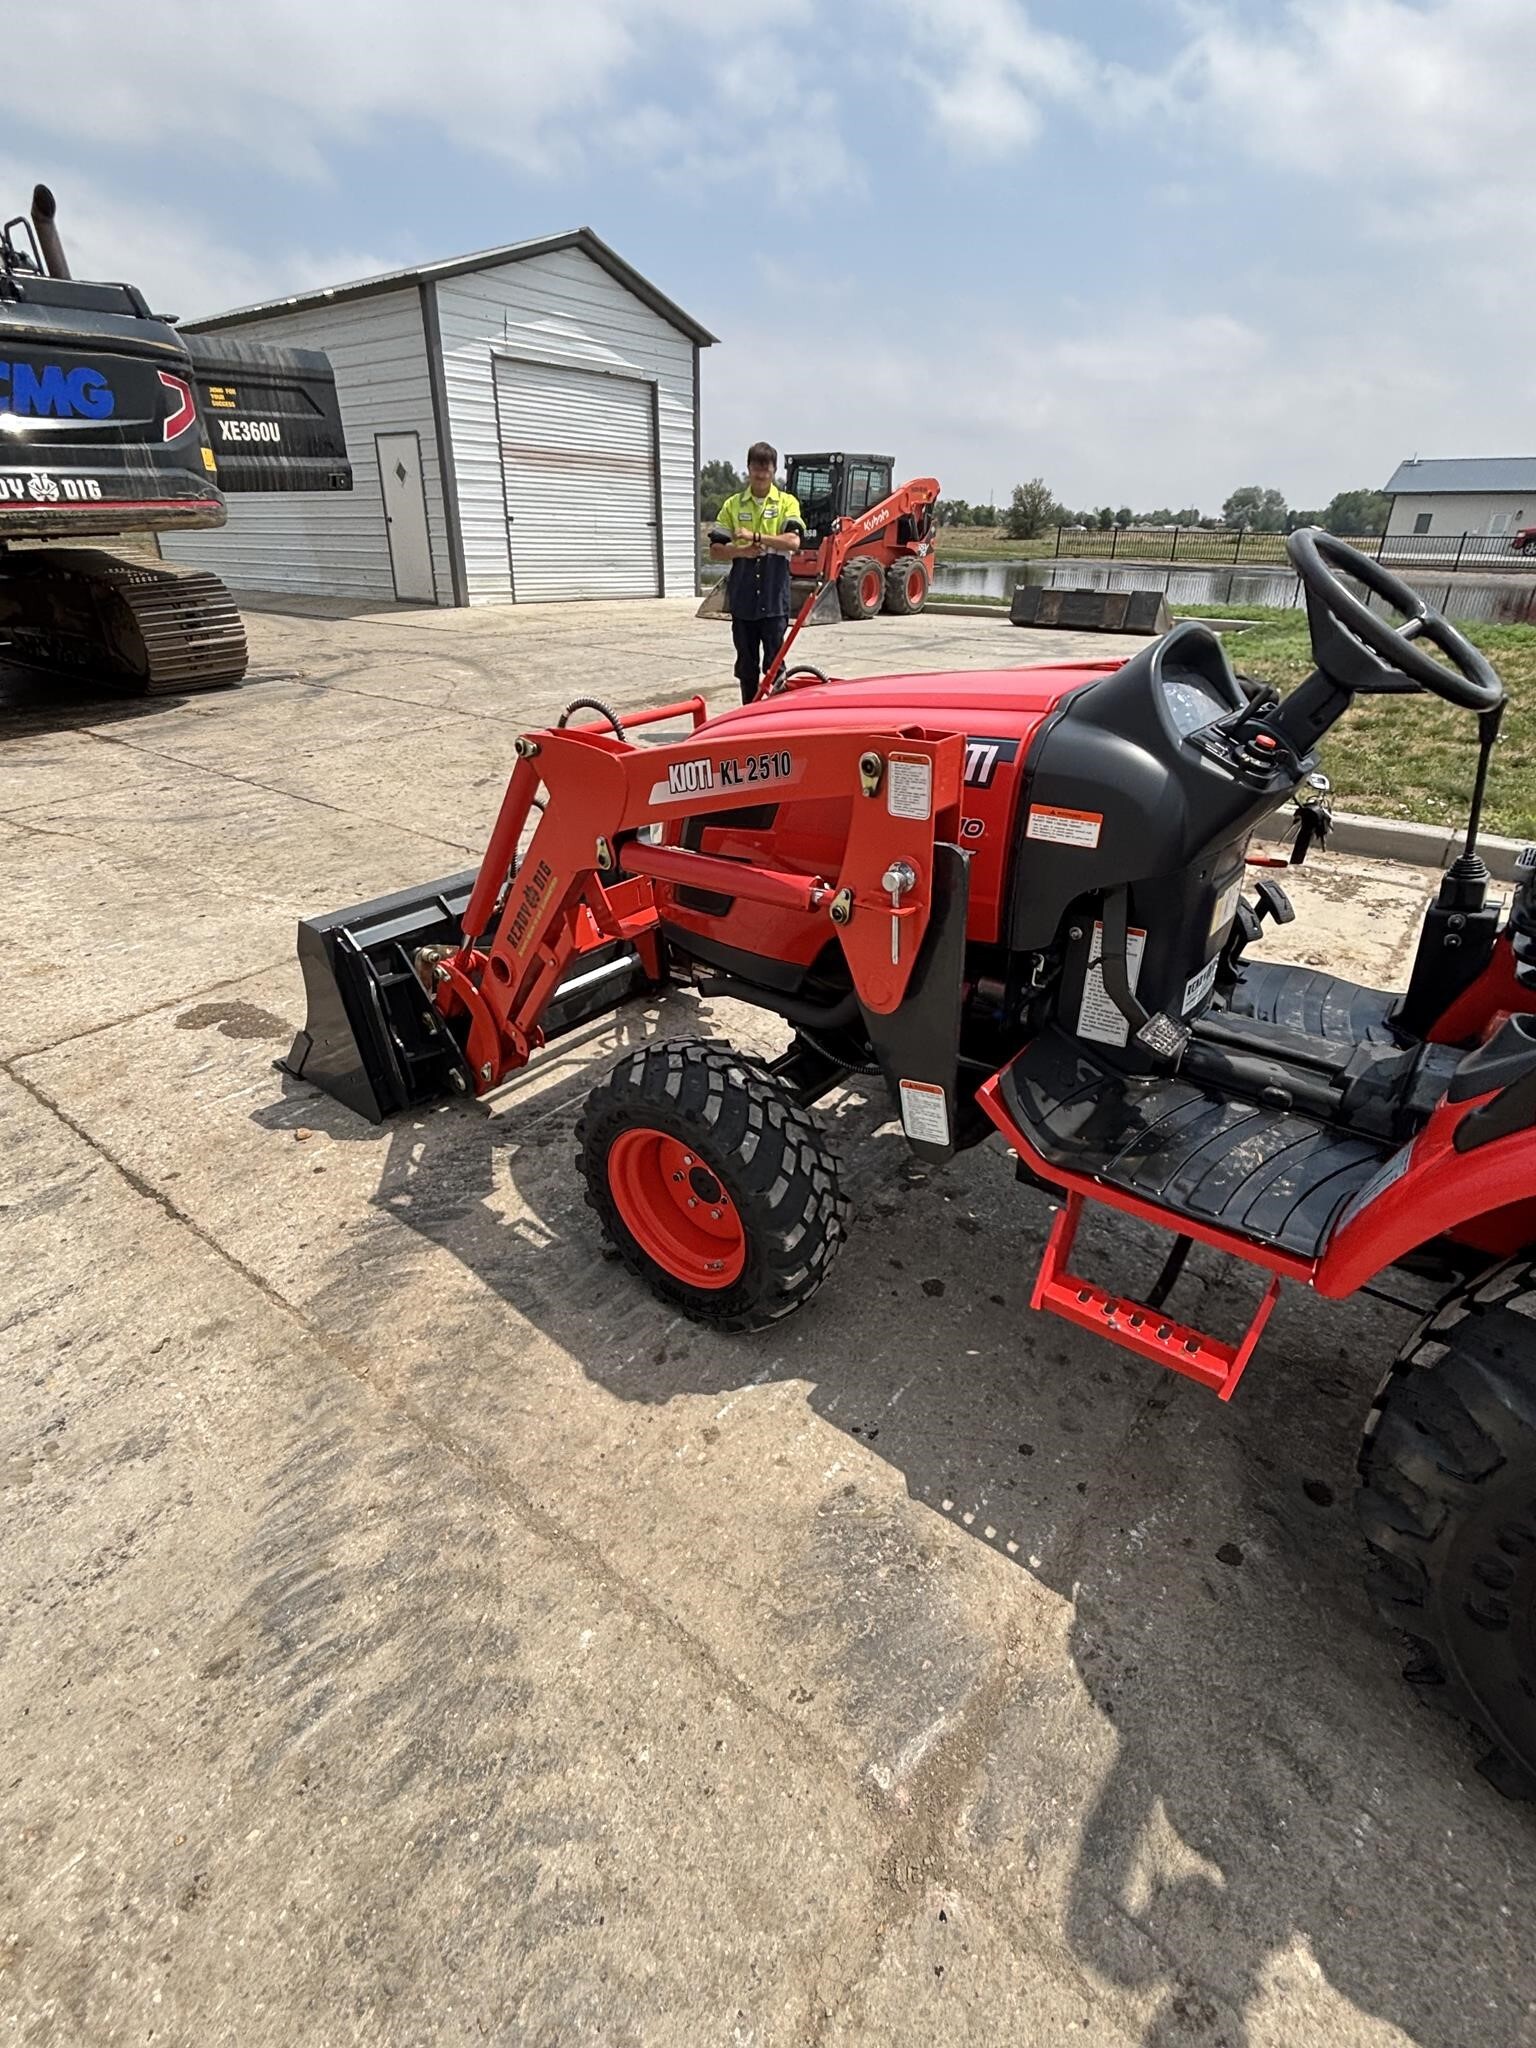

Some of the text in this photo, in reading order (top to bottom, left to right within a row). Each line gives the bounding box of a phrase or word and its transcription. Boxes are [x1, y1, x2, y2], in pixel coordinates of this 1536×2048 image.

[0, 361, 115, 419] MG
[218, 419, 281, 442] XE360U
[61, 479, 102, 500] DIG
[668, 750, 792, 794] KIOTI KL 2510
[507, 902, 532, 949] READY
[533, 860, 552, 890] DIG
